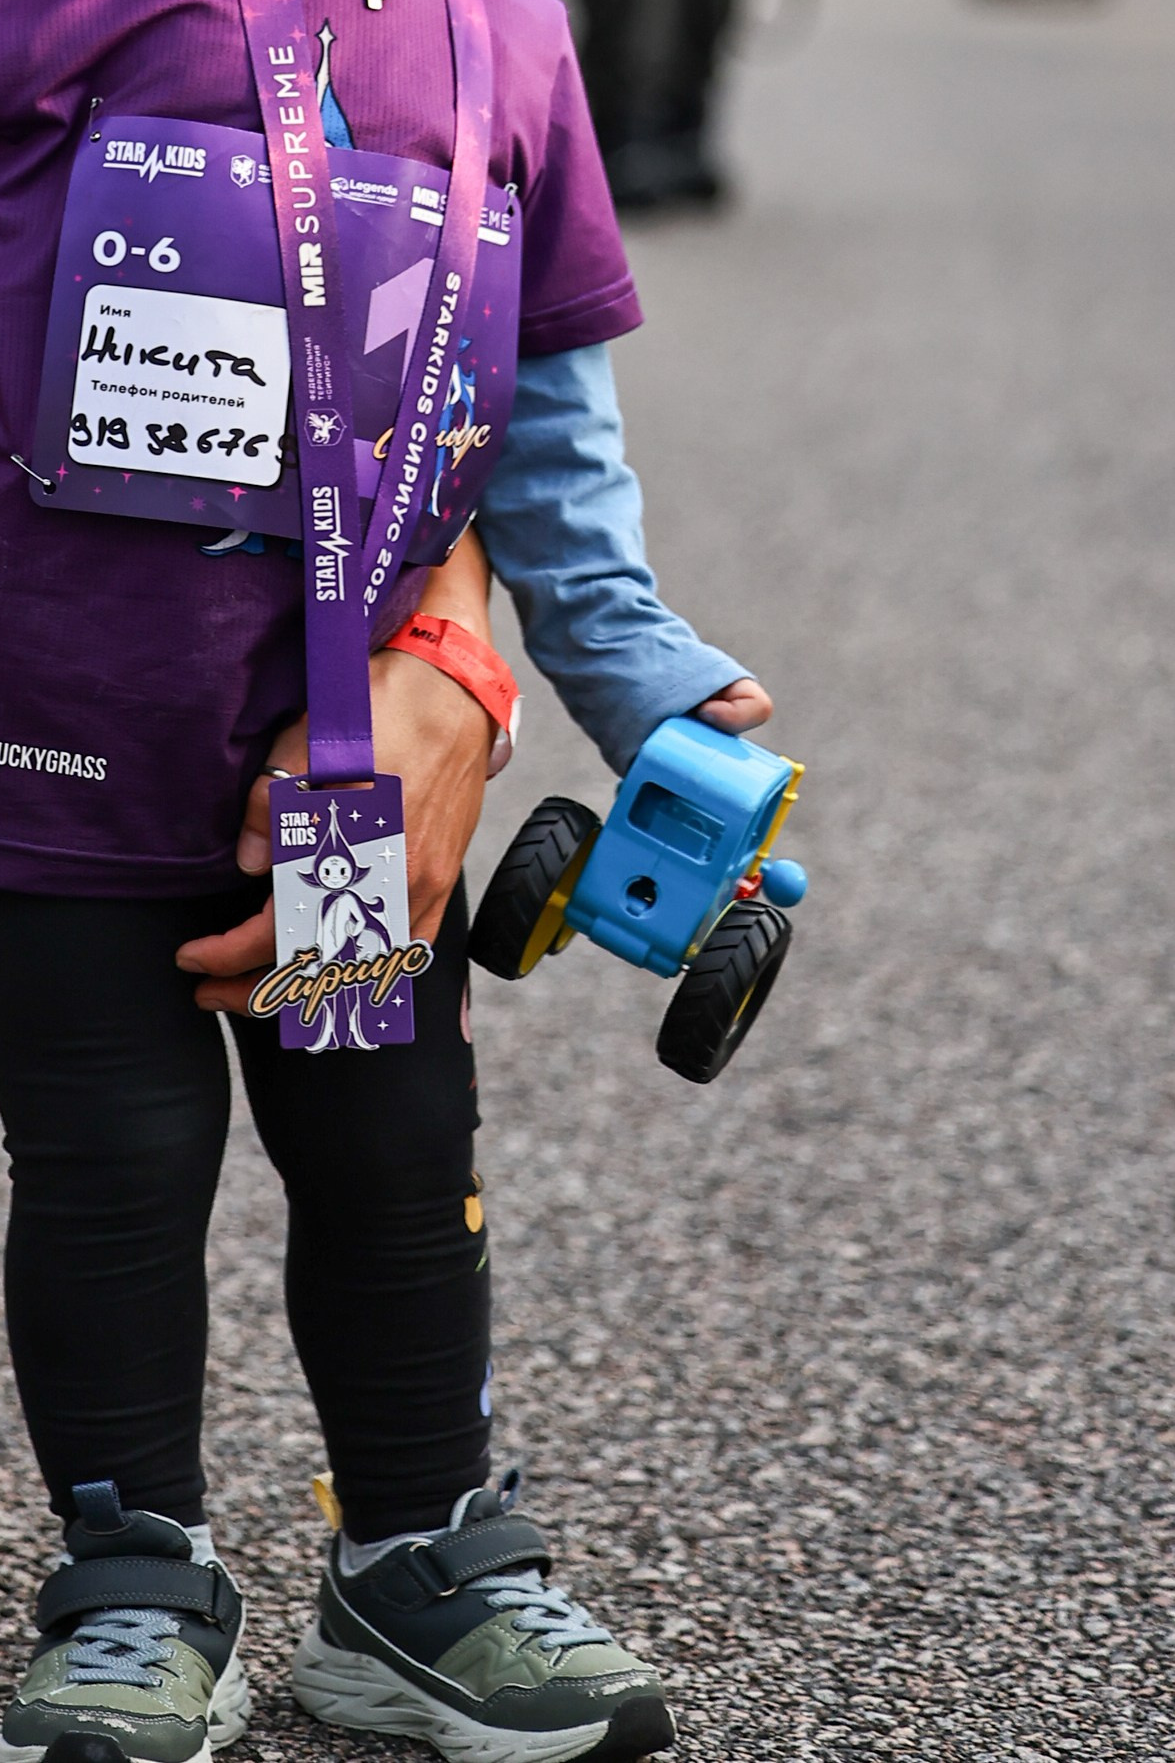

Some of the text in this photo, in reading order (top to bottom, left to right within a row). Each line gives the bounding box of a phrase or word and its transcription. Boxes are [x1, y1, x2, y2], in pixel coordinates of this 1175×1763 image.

[105, 141, 207, 170] STAR KIDS
[268, 45, 326, 307] MIR SUPREME
[349, 179, 398, 197] Legenda
[93, 230, 182, 274] 0-6
[100, 305, 132, 318] Имя
[416, 272, 462, 416] STARKIDS
[303, 336, 316, 402] ФЕДЕРАЛЬНАЯ
[314, 345, 324, 401] ТЕРРИТОРИЯ
[91, 379, 245, 409] Телефон родителей
[386, 423, 428, 543] СИРИУС
[312, 486, 337, 601] STAR KIDS
[280, 812, 310, 827] STAR
[280, 826, 317, 846] KIDS
